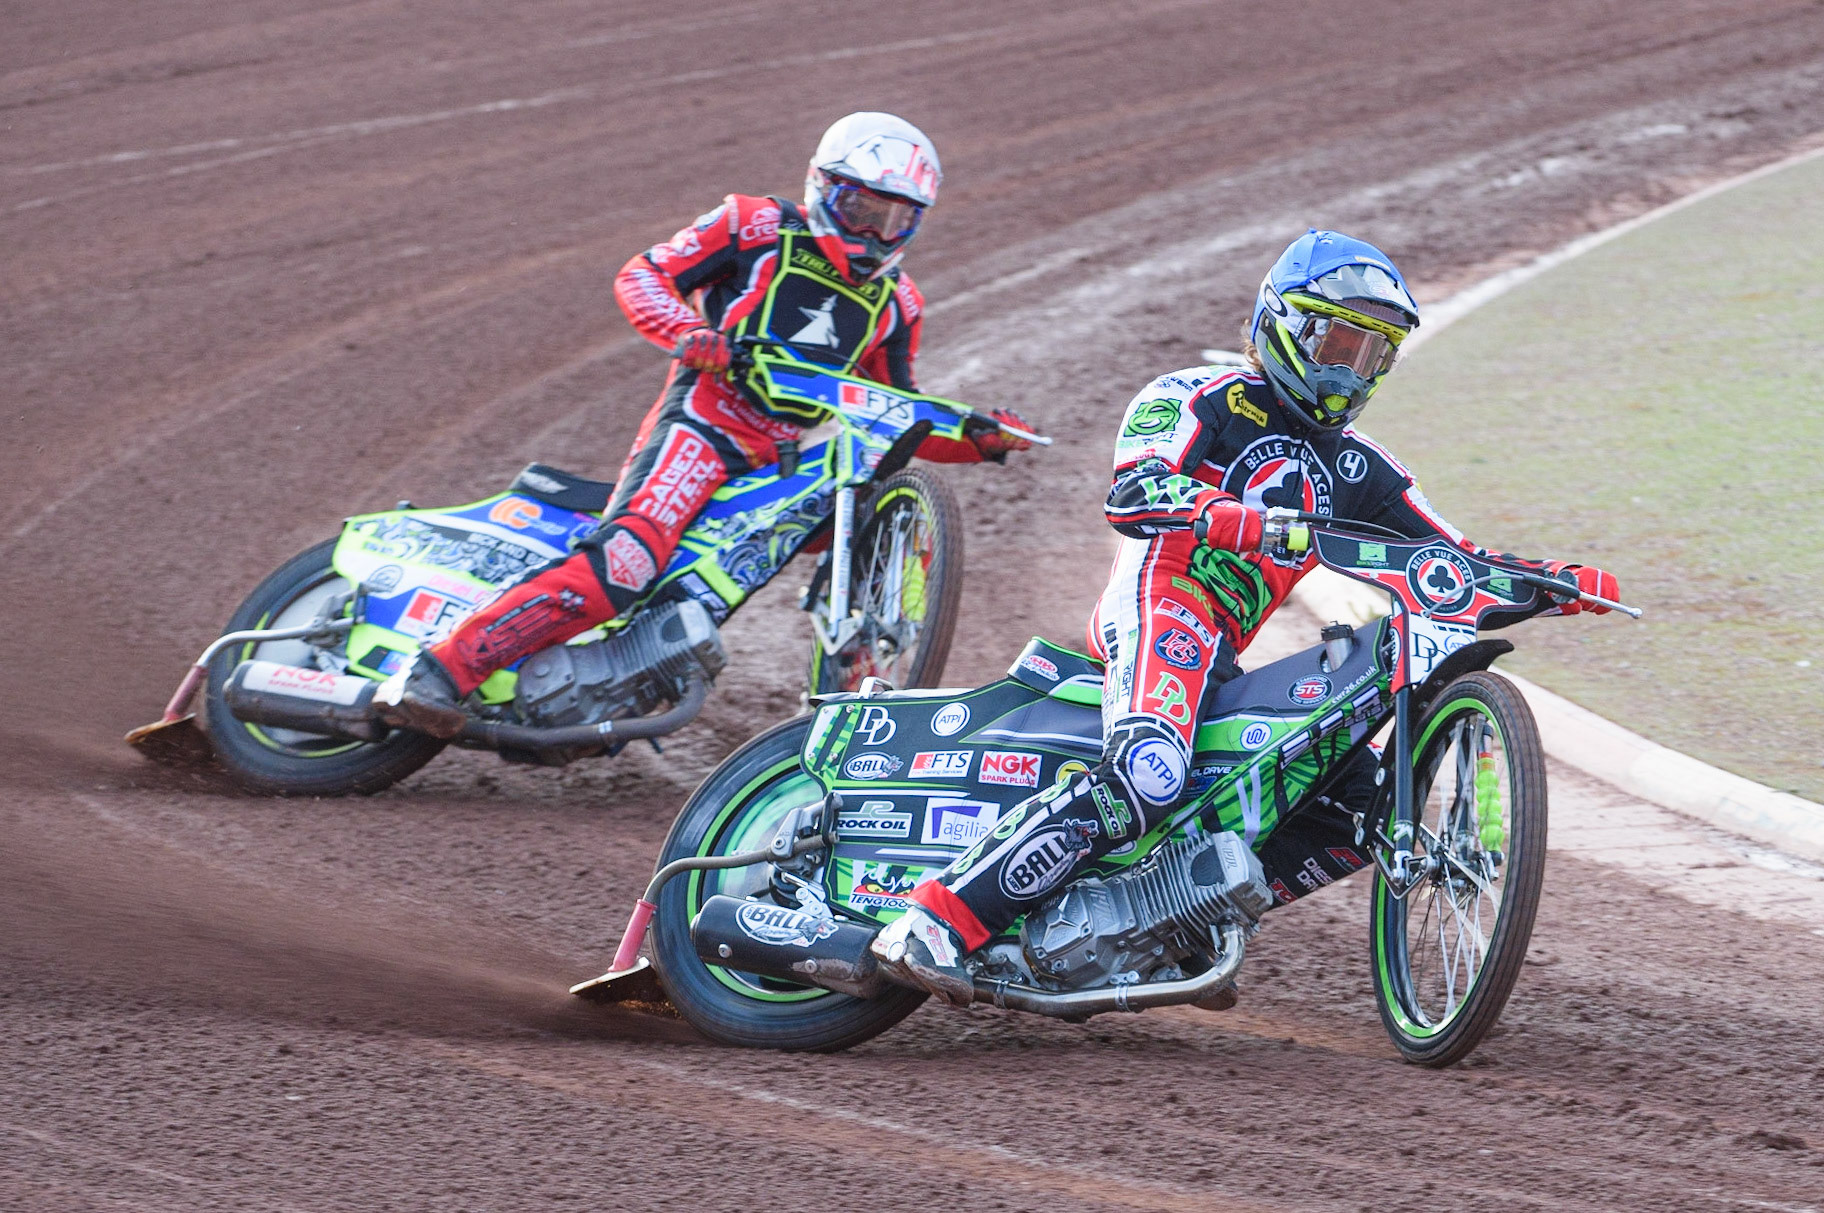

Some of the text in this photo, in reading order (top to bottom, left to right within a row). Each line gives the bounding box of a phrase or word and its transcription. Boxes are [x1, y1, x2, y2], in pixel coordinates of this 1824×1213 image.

[1244, 442, 1284, 471] BELLE
[1311, 473, 1331, 515] ACES
[1410, 550, 1472, 582] BELLE VUE ACES
[1179, 606, 1214, 645] FTS
[1294, 683, 1324, 695] STS
[938, 714, 961, 725] ATPI
[930, 752, 968, 769] FTS
[981, 753, 1039, 778] NGK
[1139, 751, 1178, 790] ATPI
[1202, 766, 1234, 776] DAVE
[980, 773, 1036, 786] SPARK PLUGS
[1096, 787, 1114, 822] ROCK
[837, 819, 908, 831] ROCK OIL
[943, 819, 989, 842] agilia
